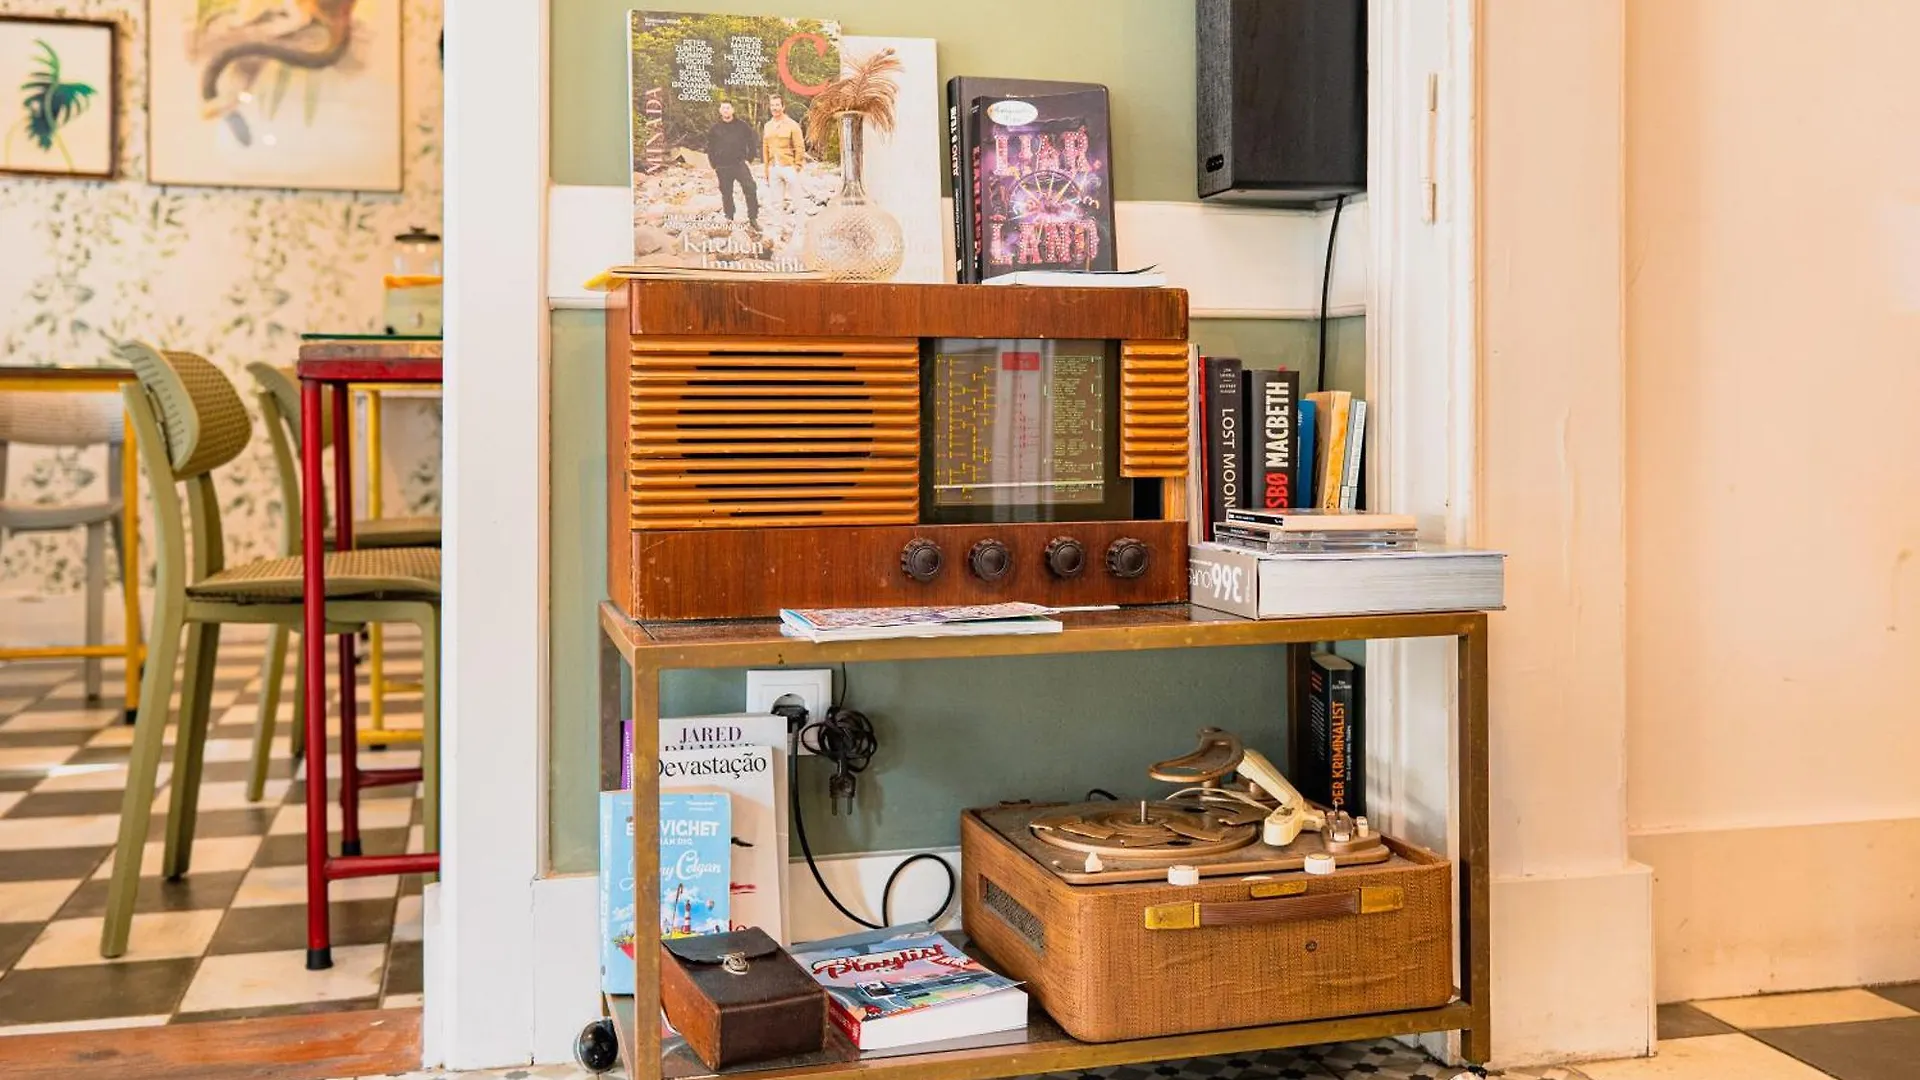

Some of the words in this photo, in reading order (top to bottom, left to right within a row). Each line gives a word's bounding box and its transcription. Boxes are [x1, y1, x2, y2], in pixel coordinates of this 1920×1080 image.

[777, 32, 829, 97] C
[683, 232, 764, 253] Kitchen
[990, 215, 1100, 266] LAND
[1222, 408, 1235, 449] LOST
[1265, 382, 1289, 467] MACBETH
[1265, 472, 1289, 511] SBØ
[1212, 563, 1243, 603] 366
[680, 726, 743, 744] JARED
[1332, 701, 1344, 778] KRIMINALIST
[1332, 782, 1344, 804] DER
[813, 944, 944, 979] Playlist
